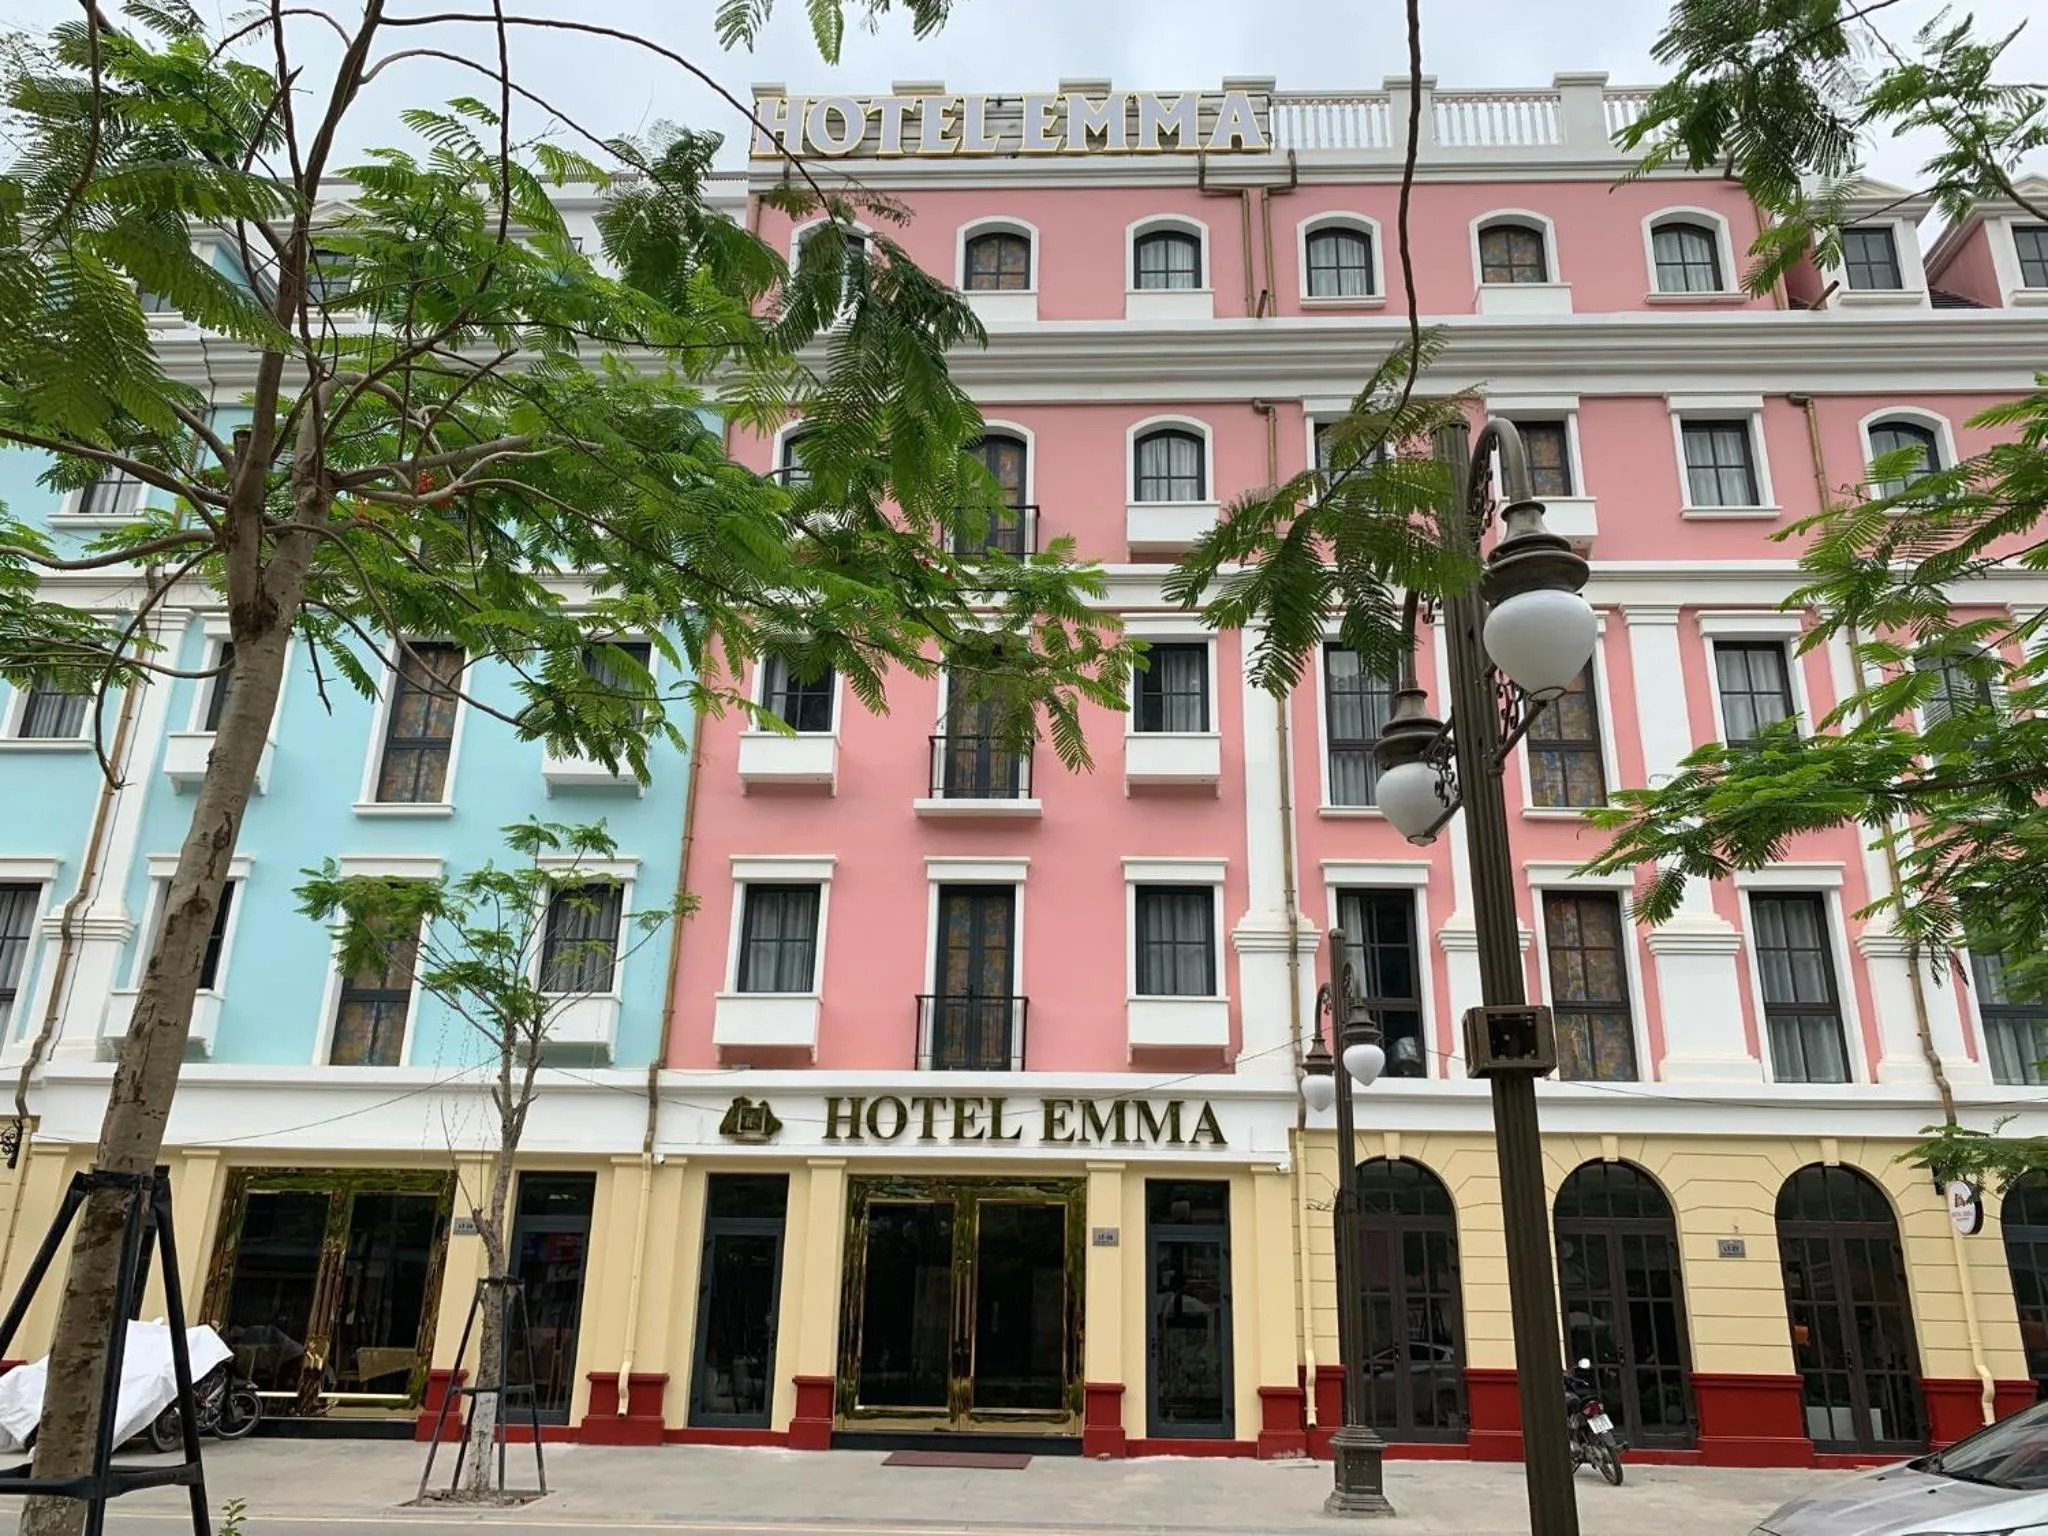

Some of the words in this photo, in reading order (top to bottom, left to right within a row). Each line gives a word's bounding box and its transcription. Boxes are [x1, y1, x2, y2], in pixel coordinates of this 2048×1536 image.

[752, 95, 1001, 156] HOTEL
[1019, 90, 1270, 154] EMMA
[822, 1096, 1023, 1140] HOTEL
[1040, 1098, 1228, 1145] EMMA
